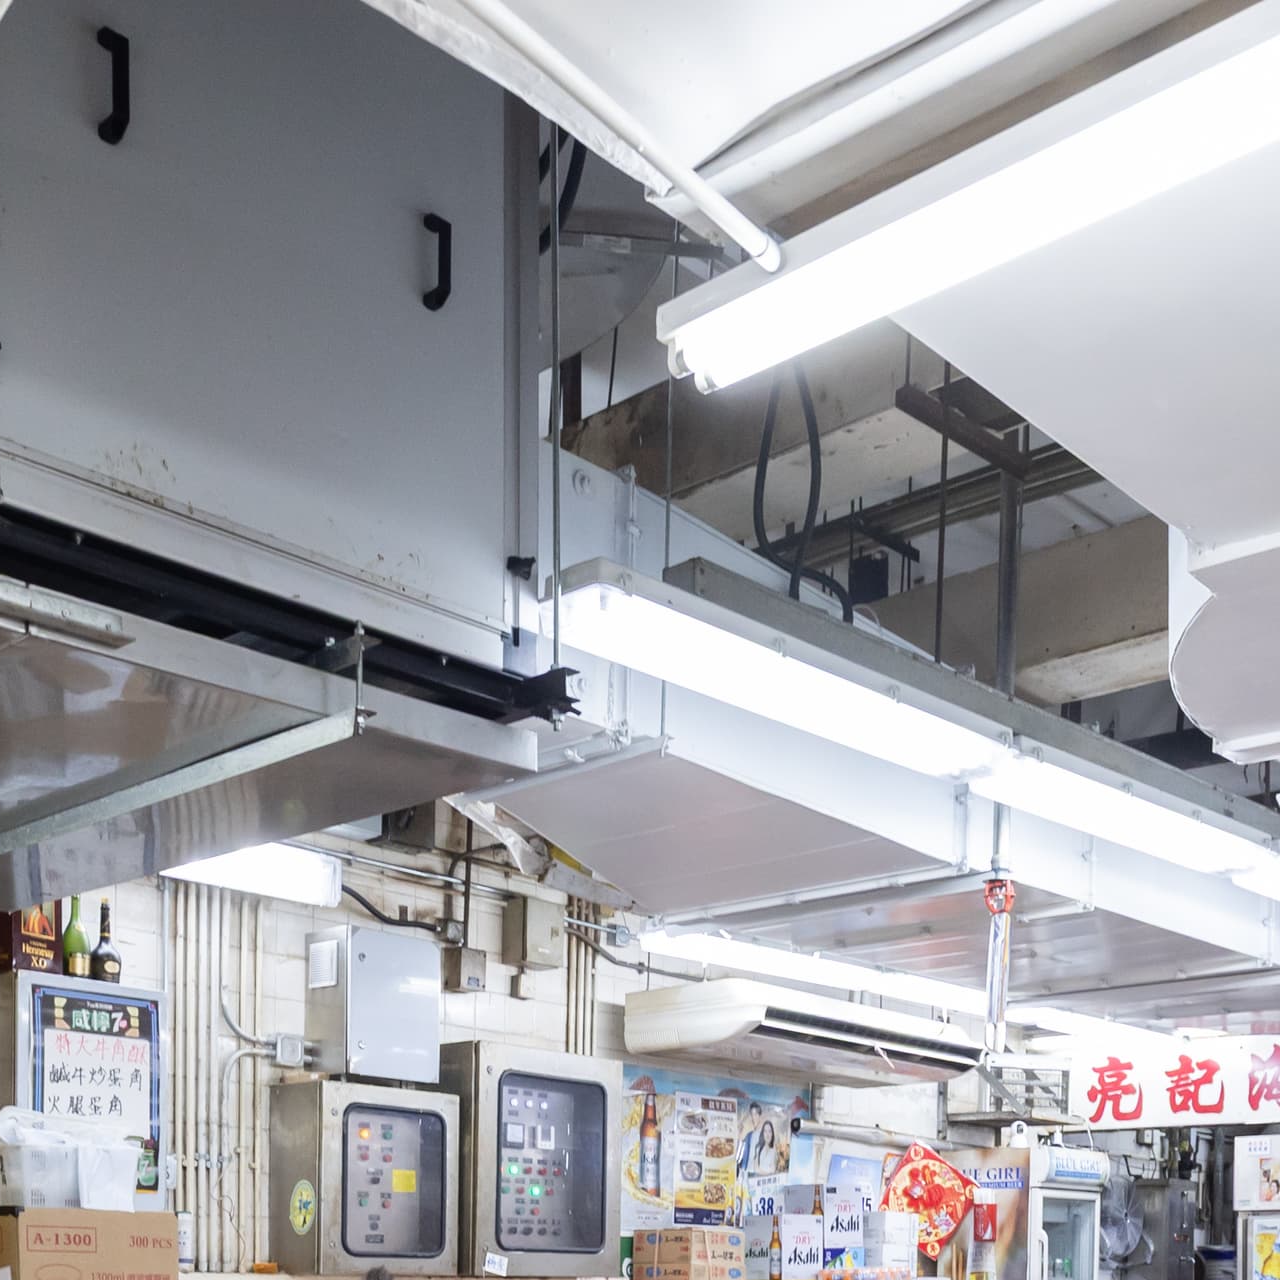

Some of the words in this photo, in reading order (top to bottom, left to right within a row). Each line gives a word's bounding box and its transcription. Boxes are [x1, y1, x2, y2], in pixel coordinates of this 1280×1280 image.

[987, 1167, 1022, 1180] GIRL
[830, 1214, 861, 1233] Asahi
[33, 1233, 92, 1246] A-1300
[129, 1236, 149, 1249] 300
[152, 1238, 172, 1249] PCS
[788, 1246, 820, 1265] Asahi
